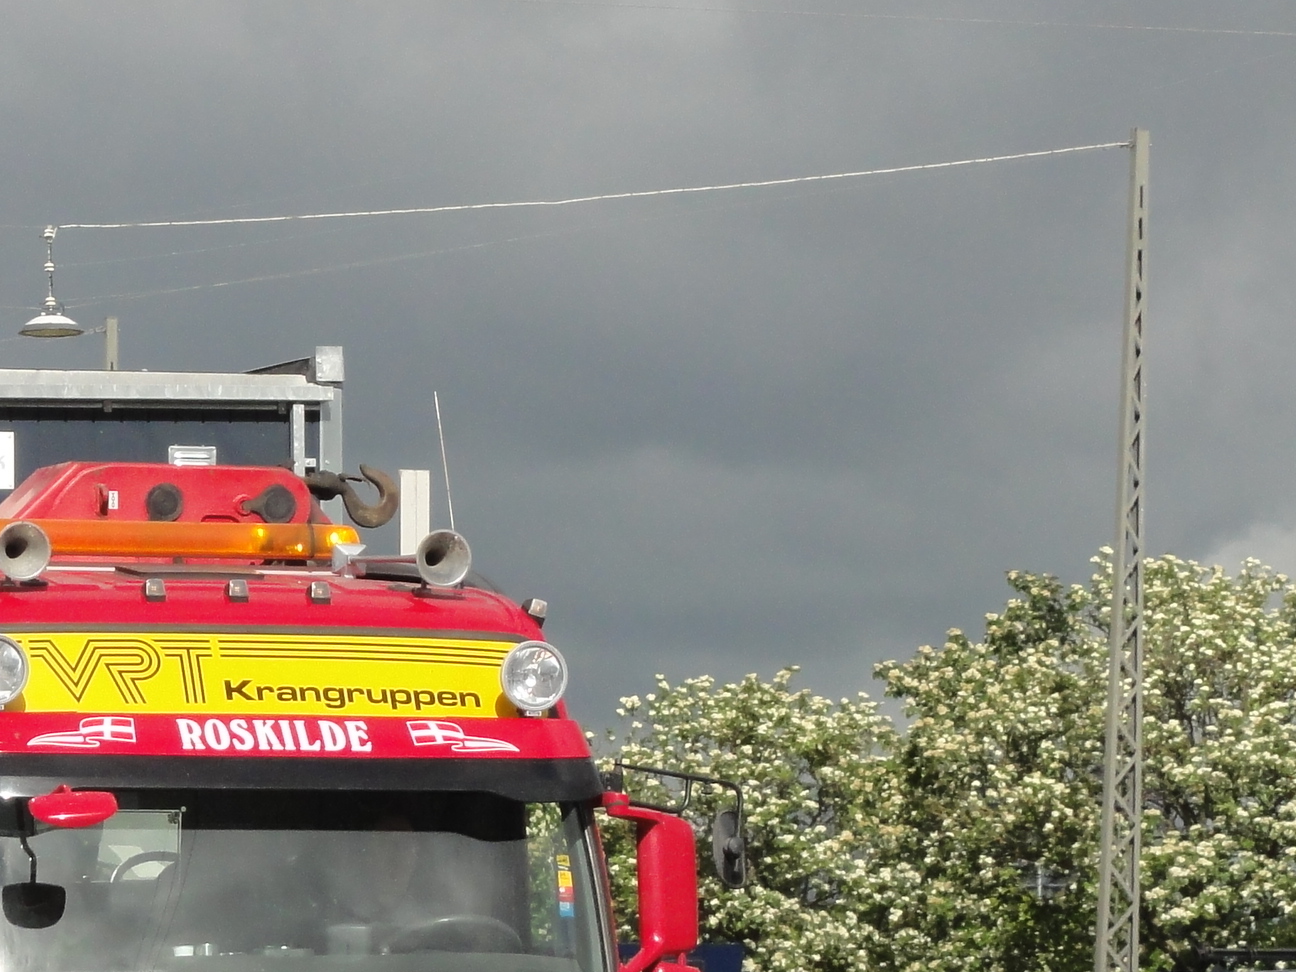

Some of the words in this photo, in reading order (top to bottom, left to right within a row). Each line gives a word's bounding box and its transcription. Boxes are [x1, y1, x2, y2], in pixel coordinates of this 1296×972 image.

[28, 639, 213, 704] VRT
[224, 679, 481, 711] Krangruppen
[176, 718, 373, 752] ROSKILDE
